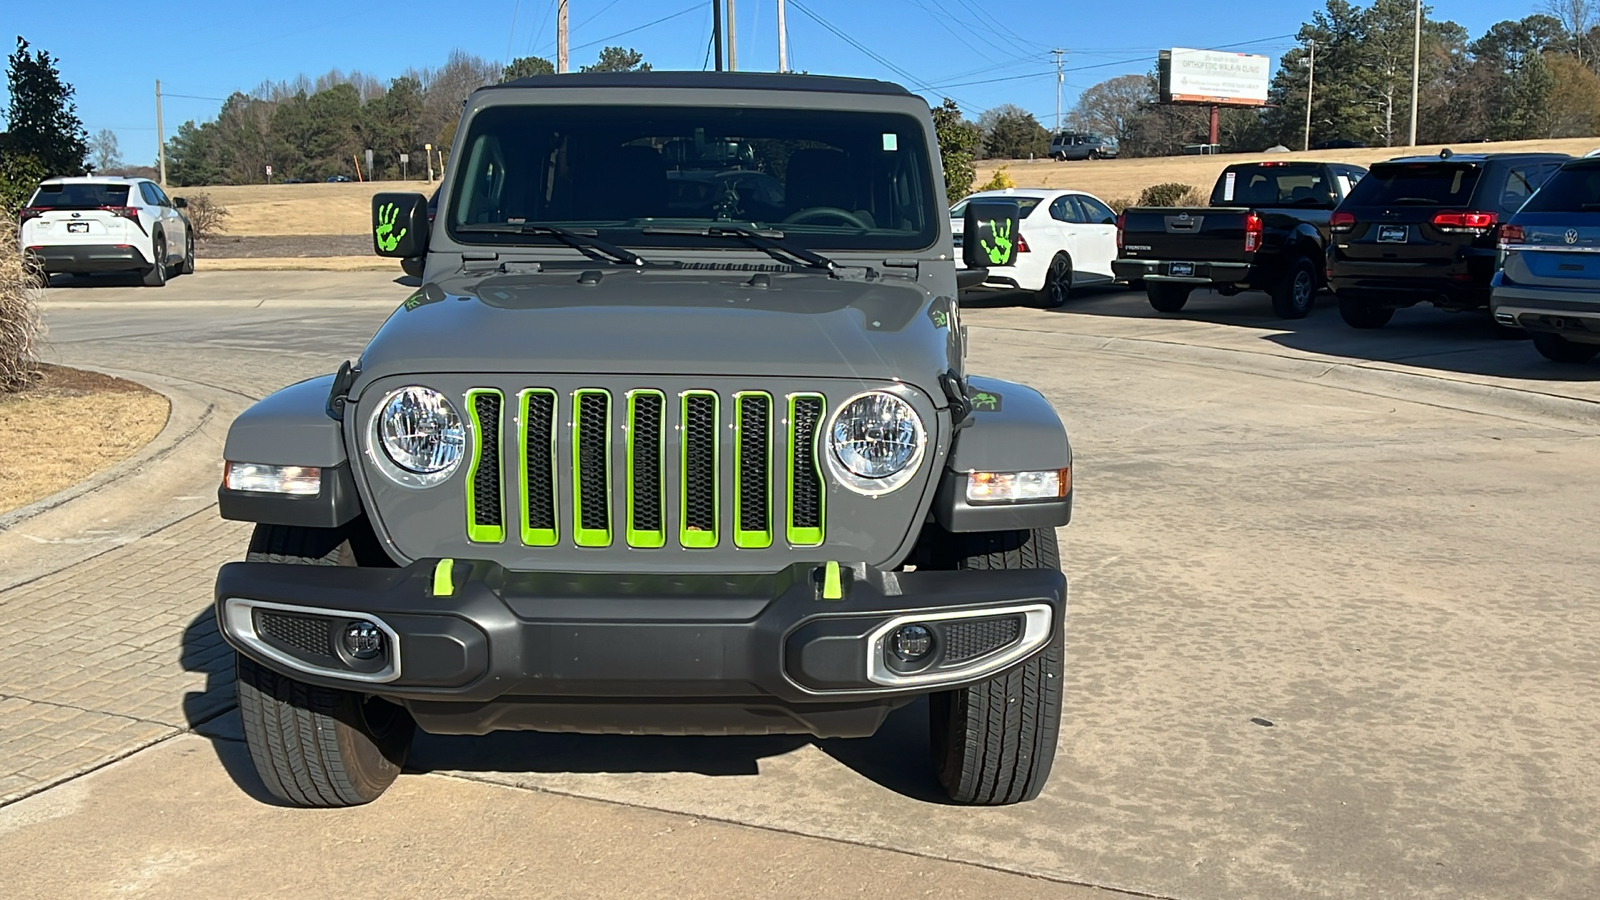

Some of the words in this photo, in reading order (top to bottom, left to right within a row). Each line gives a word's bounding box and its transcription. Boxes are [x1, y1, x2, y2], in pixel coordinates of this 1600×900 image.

[1182, 60, 1218, 70] ORTHOPEDIC
[1219, 63, 1241, 72] WALK-IN
[1242, 65, 1260, 74] CLINIC
